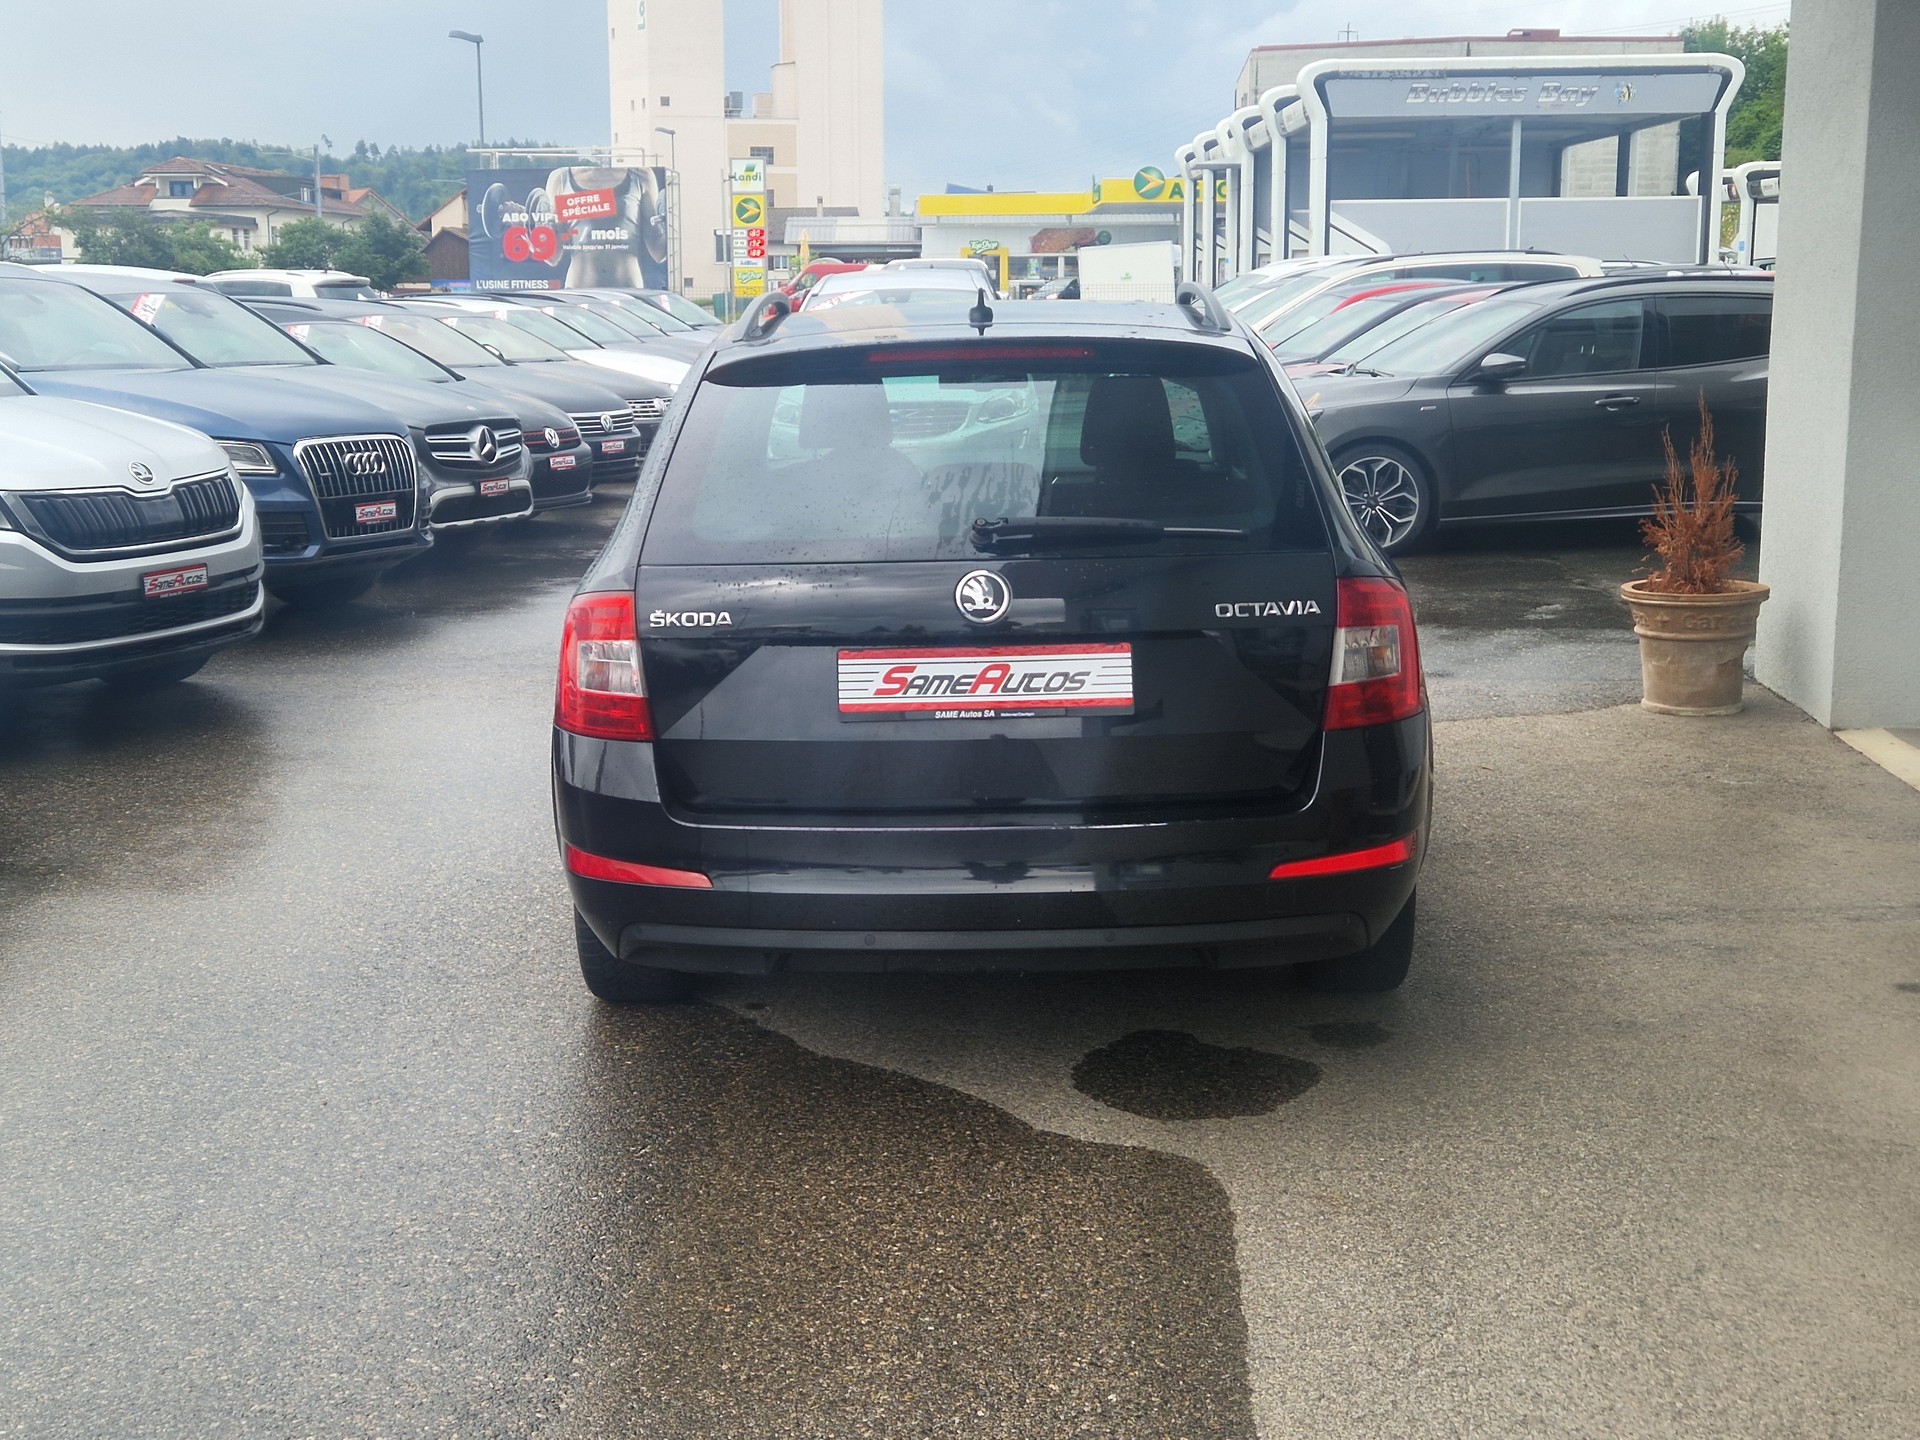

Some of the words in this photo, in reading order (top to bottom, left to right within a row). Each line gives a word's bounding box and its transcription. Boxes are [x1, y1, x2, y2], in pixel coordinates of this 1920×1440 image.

[1406, 82, 1528, 104] Bubbles
[1537, 81, 1599, 107] Bay
[734, 172, 762, 182] Landi
[566, 194, 600, 207] OFFRE
[562, 202, 611, 217] SPÉCIALE
[502, 212, 528, 223] ABO
[591, 226, 629, 240] mois
[476, 280, 510, 289] L'USINE
[510, 280, 549, 289] FITNESS
[1215, 600, 1321, 618] OCTAVIA
[650, 610, 733, 628] ŠKODA
[935, 711, 958, 719] SAME
[960, 710, 982, 718] Autos
[983, 709, 996, 718] SA
